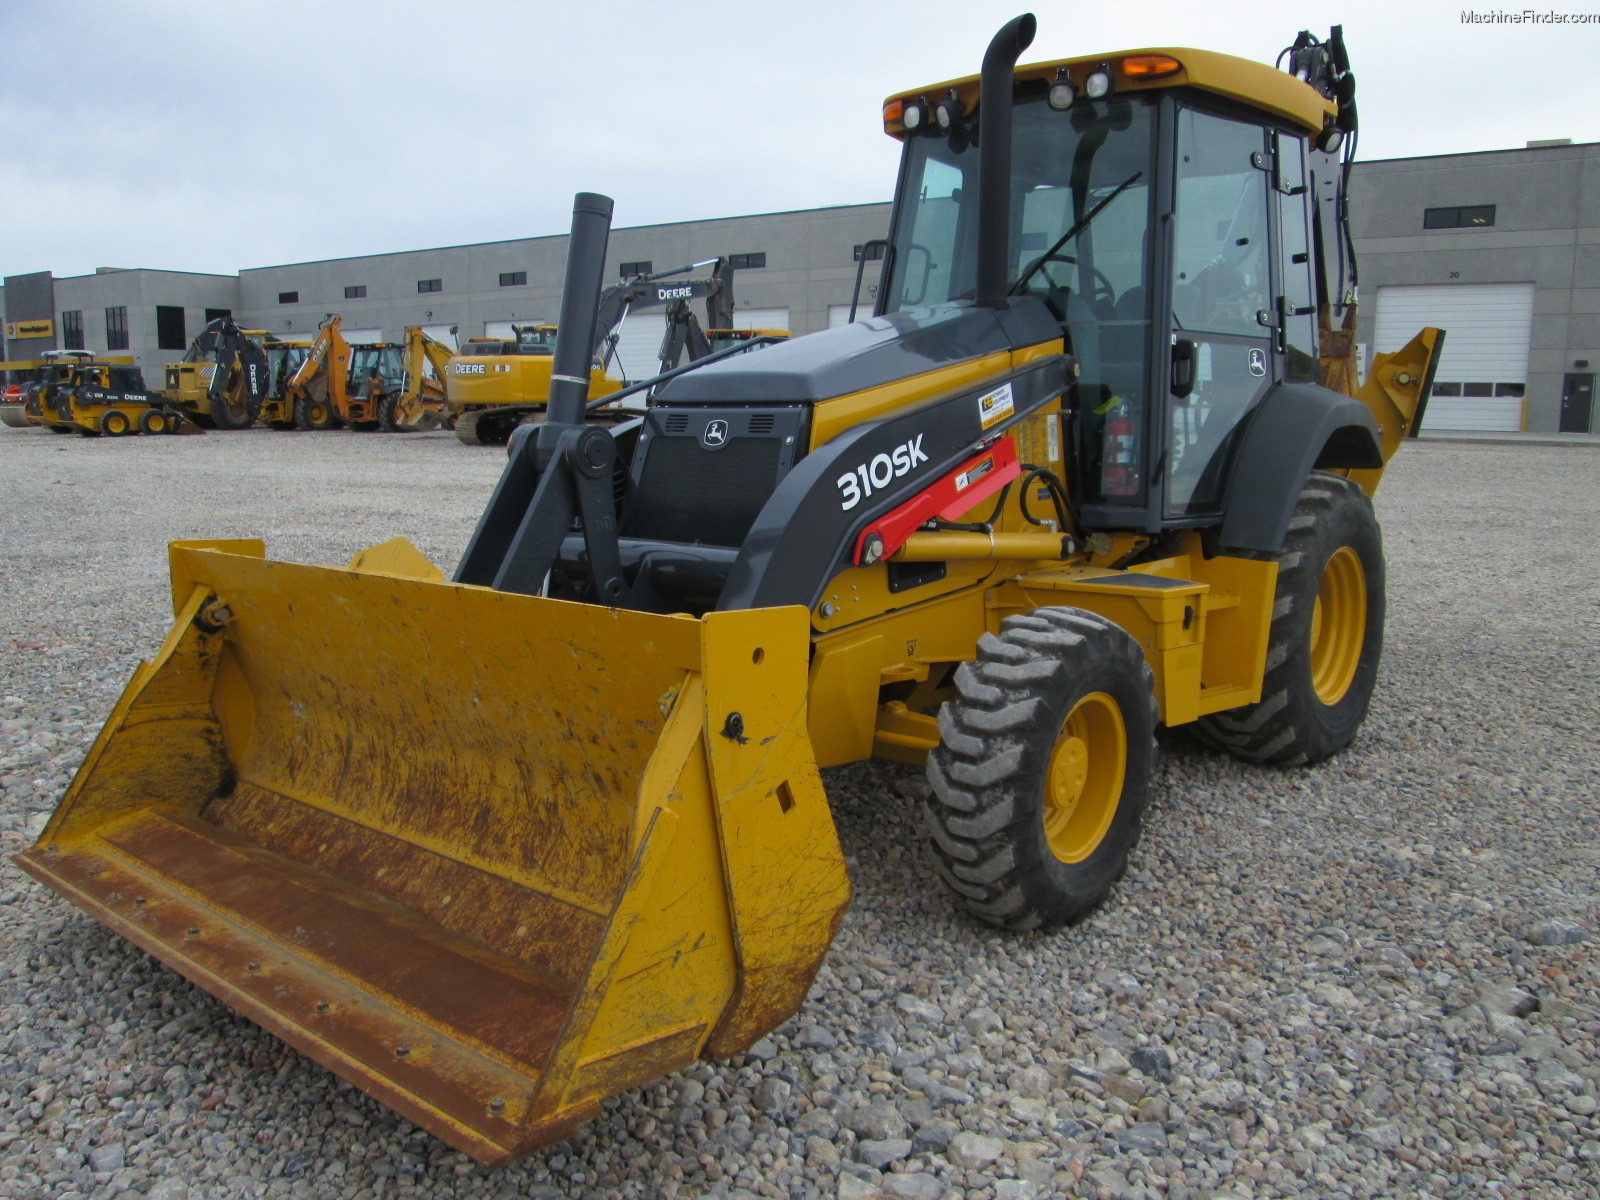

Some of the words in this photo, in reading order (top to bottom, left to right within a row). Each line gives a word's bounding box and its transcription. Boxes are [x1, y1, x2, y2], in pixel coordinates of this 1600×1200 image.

[1449, 271, 1460, 279] 20
[658, 286, 692, 300] DEERE
[456, 363, 486, 374] DEERE
[249, 364, 258, 395] DEERE
[124, 393, 148, 401] DEERE
[837, 432, 929, 511] 310SK
